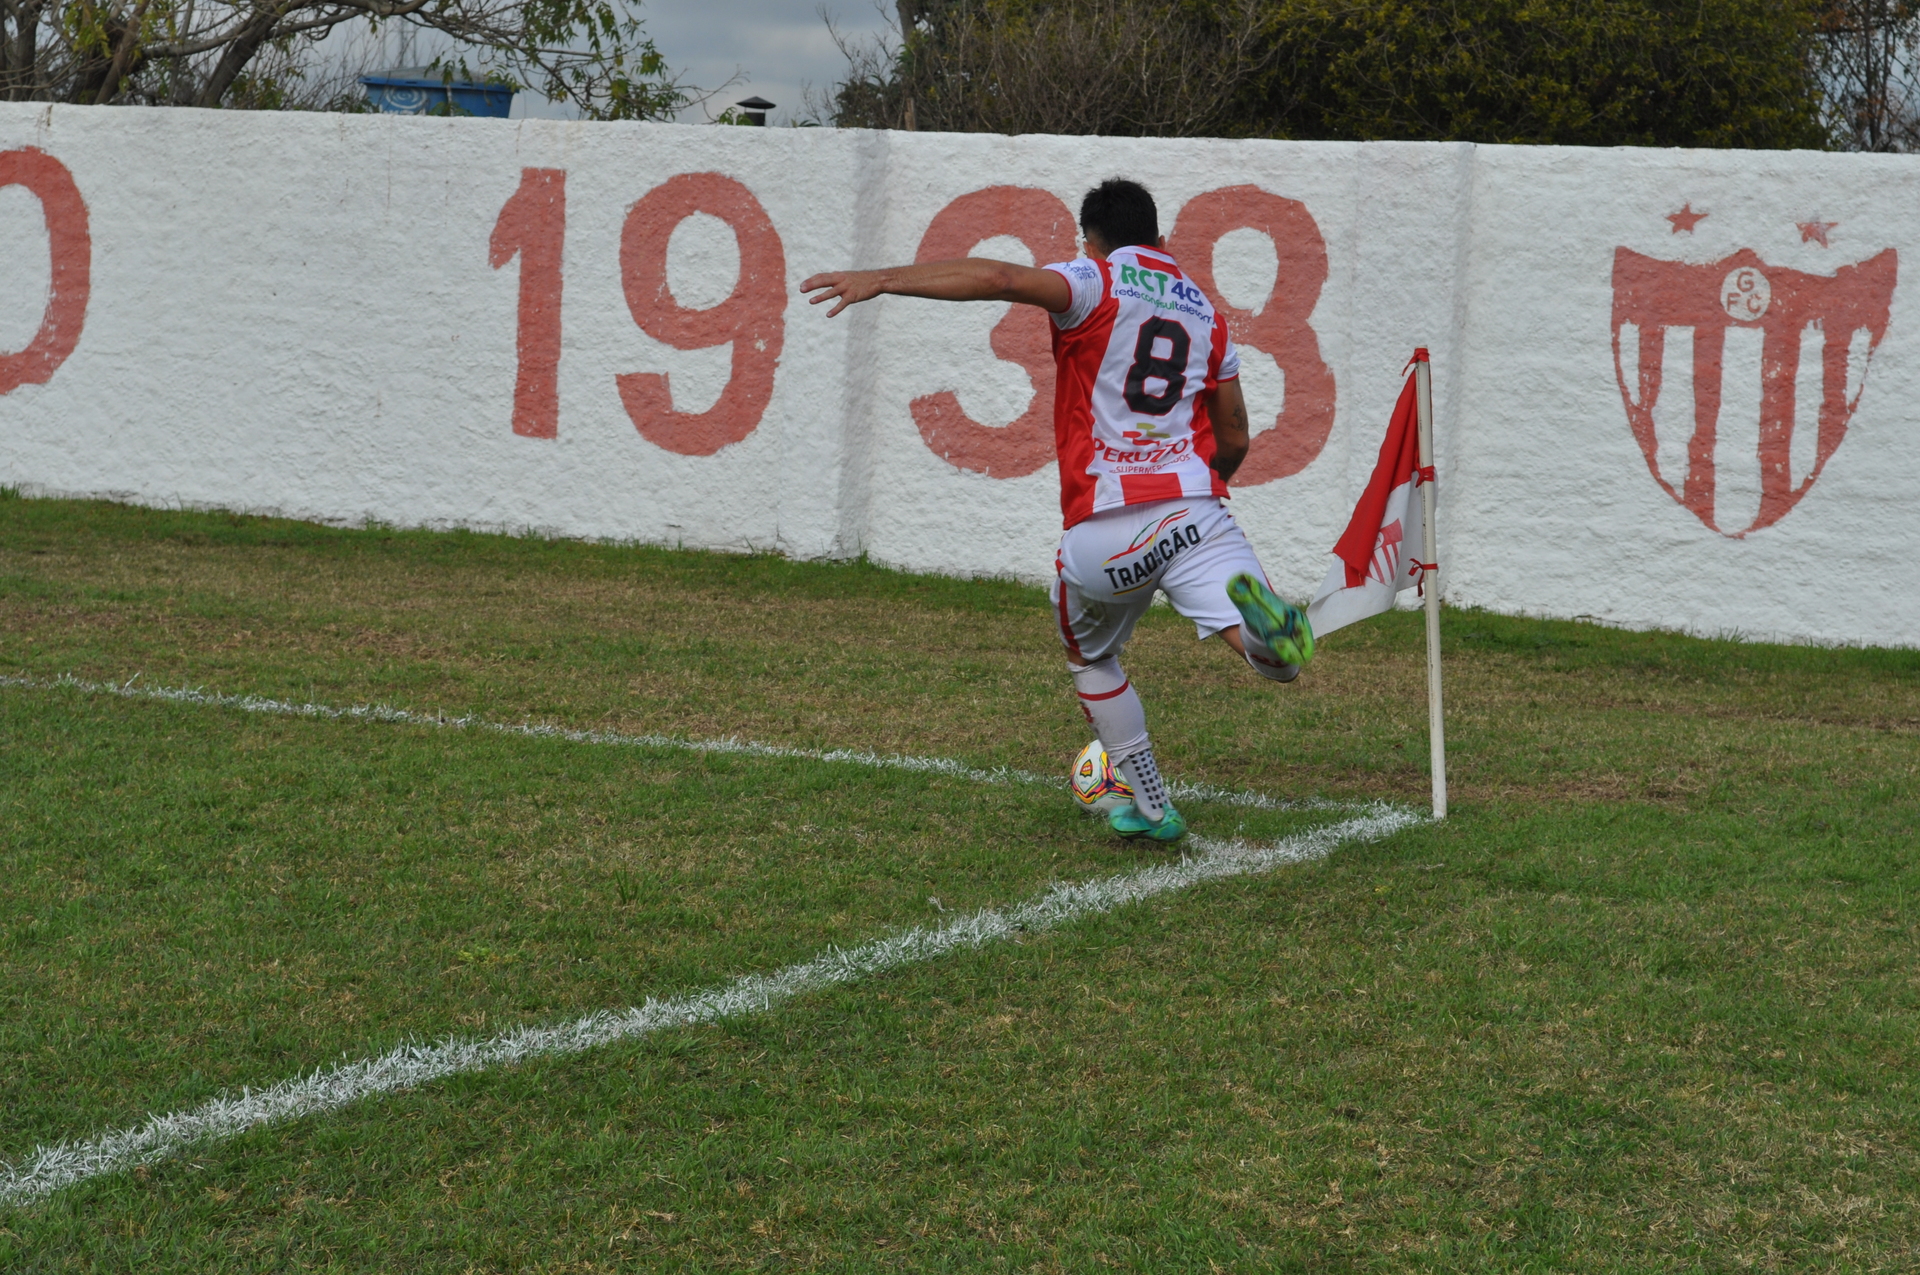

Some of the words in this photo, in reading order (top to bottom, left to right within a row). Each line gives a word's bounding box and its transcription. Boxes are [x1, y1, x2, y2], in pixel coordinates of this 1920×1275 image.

[489, 167, 1336, 487] 1938
[1121, 263, 1168, 297] RCT
[1123, 315, 1191, 416] 8
